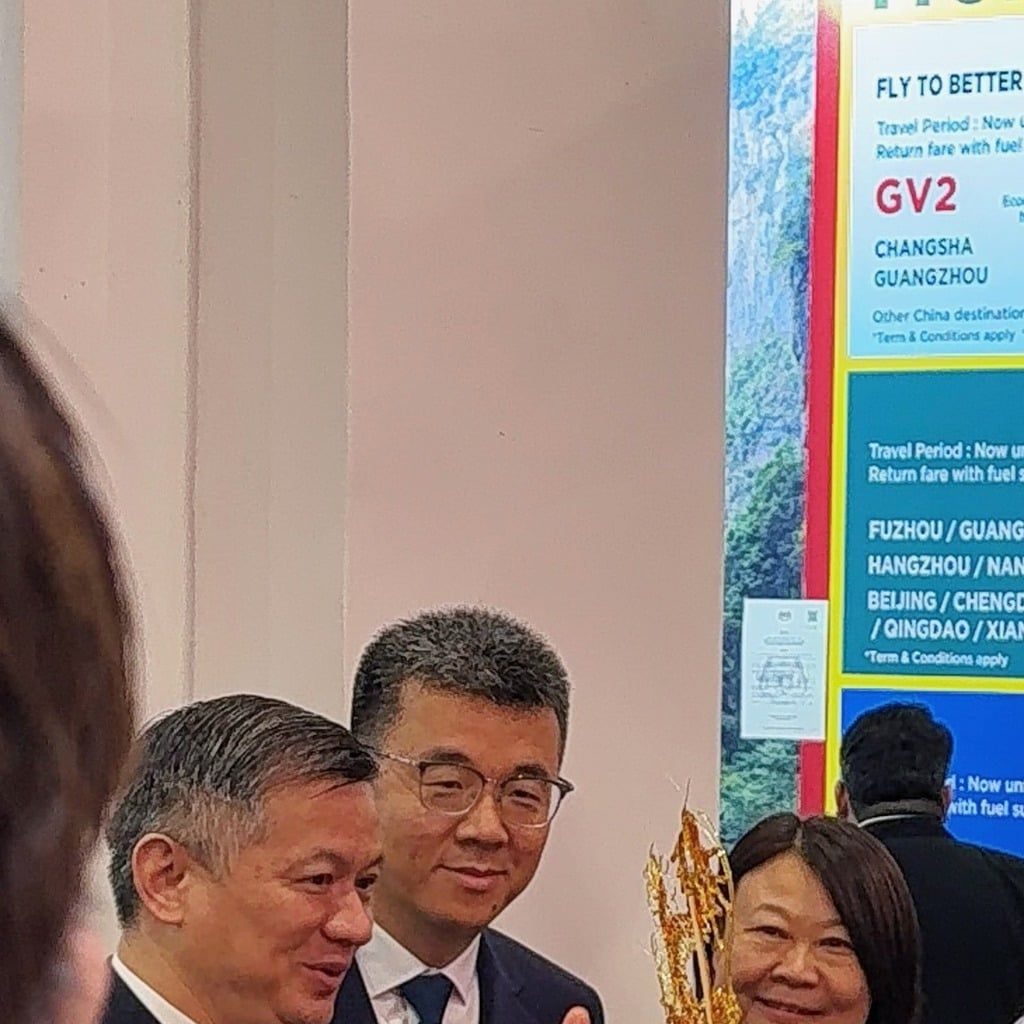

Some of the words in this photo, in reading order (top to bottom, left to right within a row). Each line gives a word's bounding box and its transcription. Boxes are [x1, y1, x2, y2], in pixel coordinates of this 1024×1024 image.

[876, 76, 911, 98] FLY
[917, 74, 943, 96] TO
[950, 70, 1023, 94] BETTER
[877, 119, 918, 136] Travel
[922, 116, 970, 134] Period
[982, 116, 1015, 131] Now
[876, 144, 923, 159] Return
[928, 141, 955, 157] fare
[960, 138, 990, 155] with
[995, 136, 1023, 153] fuel
[876, 176, 957, 214] GV2
[875, 237, 974, 258] CHANGSHA
[874, 266, 988, 288] GUANGZHOU
[872, 309, 909, 323] Other
[914, 308, 950, 322] China
[920, 329, 980, 343] Conditions
[983, 329, 1016, 343] apply
[868, 442, 912, 459] Travel
[915, 441, 963, 459] Period
[974, 442, 1007, 458] Now
[868, 466, 917, 482] Return
[920, 465, 949, 482] fare
[952, 464, 984, 482] with
[987, 464, 1016, 482] fuel
[868, 520, 943, 540] FUZHOU
[868, 555, 971, 576] HANGZHOU
[867, 591, 937, 611] BEIJING
[884, 619, 970, 641] QINGDAO
[912, 651, 973, 666] Conditions
[976, 652, 1009, 668] apply
[967, 775, 1002, 793] Now
[980, 800, 1009, 817] fuel
